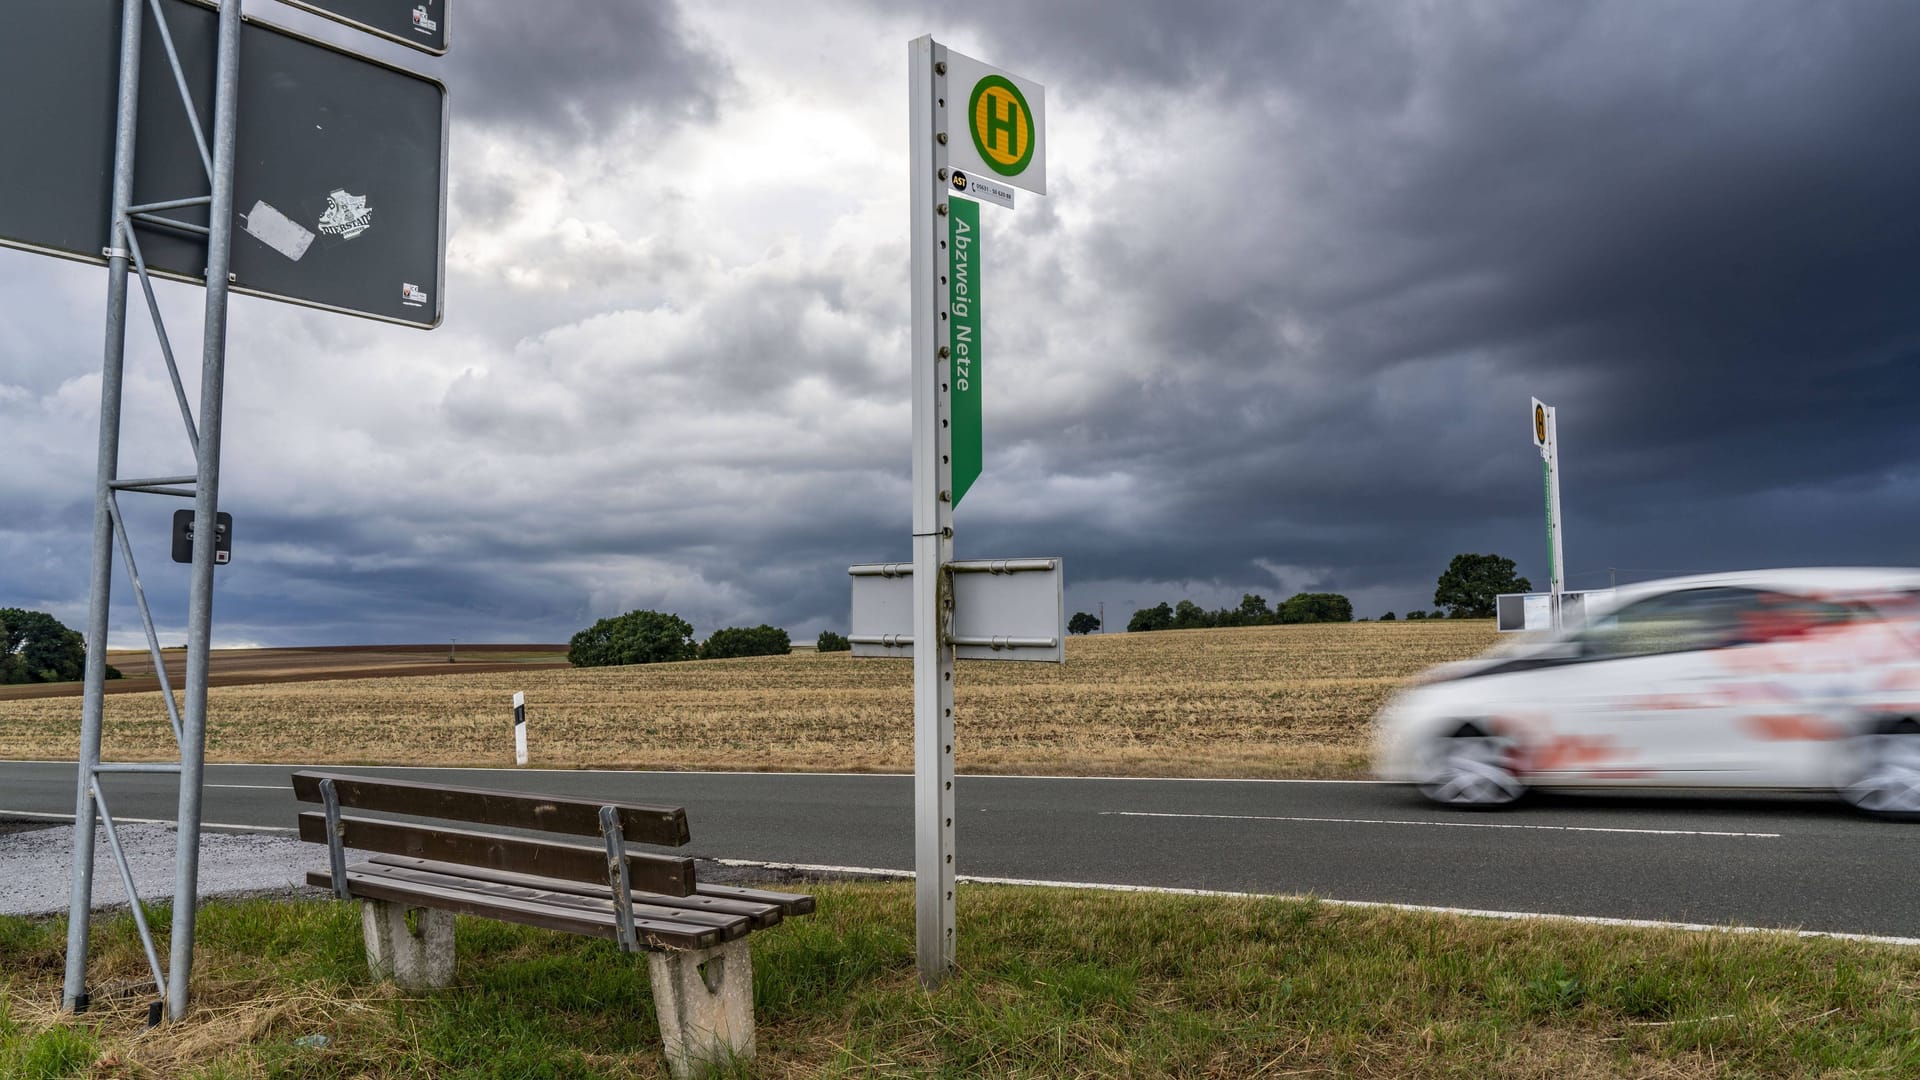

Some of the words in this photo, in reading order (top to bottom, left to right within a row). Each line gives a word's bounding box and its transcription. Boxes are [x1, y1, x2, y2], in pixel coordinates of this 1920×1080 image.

[987, 93, 1018, 158] H
[953, 175, 966, 187] AST
[952, 217, 972, 318] Abzweig
[956, 325, 972, 391] Netze
